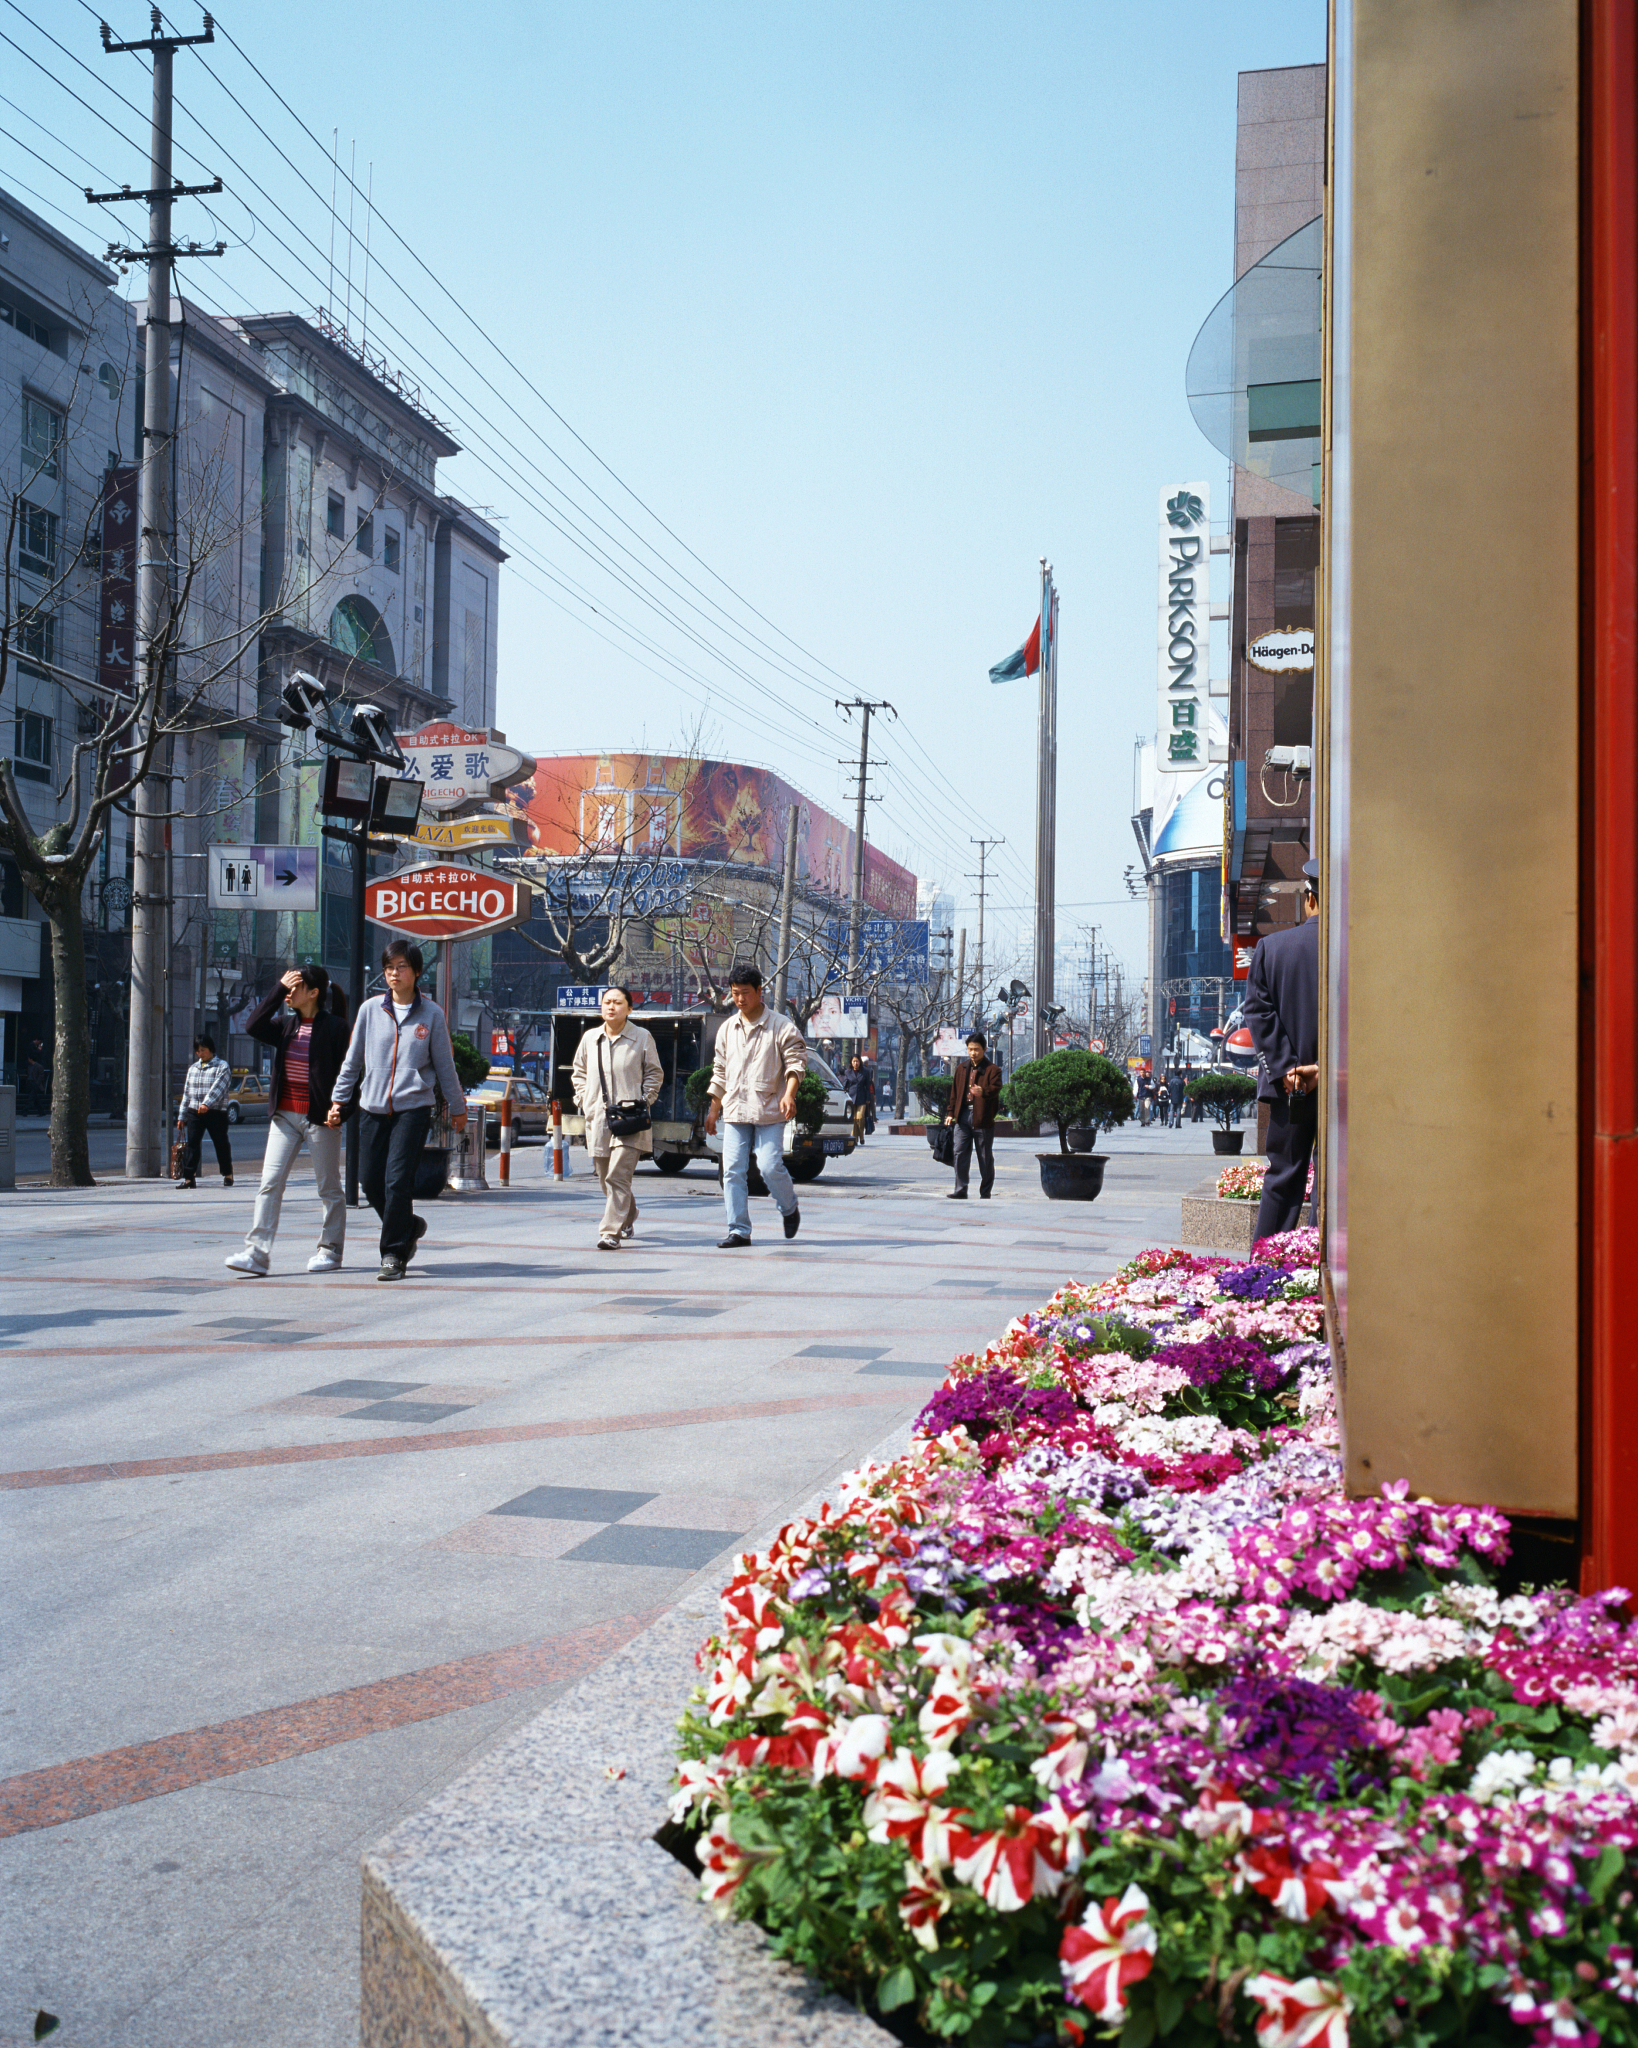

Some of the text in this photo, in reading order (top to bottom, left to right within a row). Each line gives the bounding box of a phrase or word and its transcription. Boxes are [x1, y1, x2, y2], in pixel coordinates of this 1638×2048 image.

[1167, 535, 1200, 761] PARKSON 百盛
[409, 733, 479, 746] 自助式卡拉 OK
[396, 751, 490, 781] 必爱歌
[422, 787, 466, 798] BIG ECHO
[414, 825, 455, 844] LAZA
[464, 825, 496, 834] 欢迎光临
[400, 871, 478, 884] 自助式卡拉OK
[607, 861, 684, 888] 17908
[376, 889, 505, 919] BIG ECHO
[629, 972, 730, 988] 上海市第食品商店
[559, 996, 596, 1007] 地下停车库
